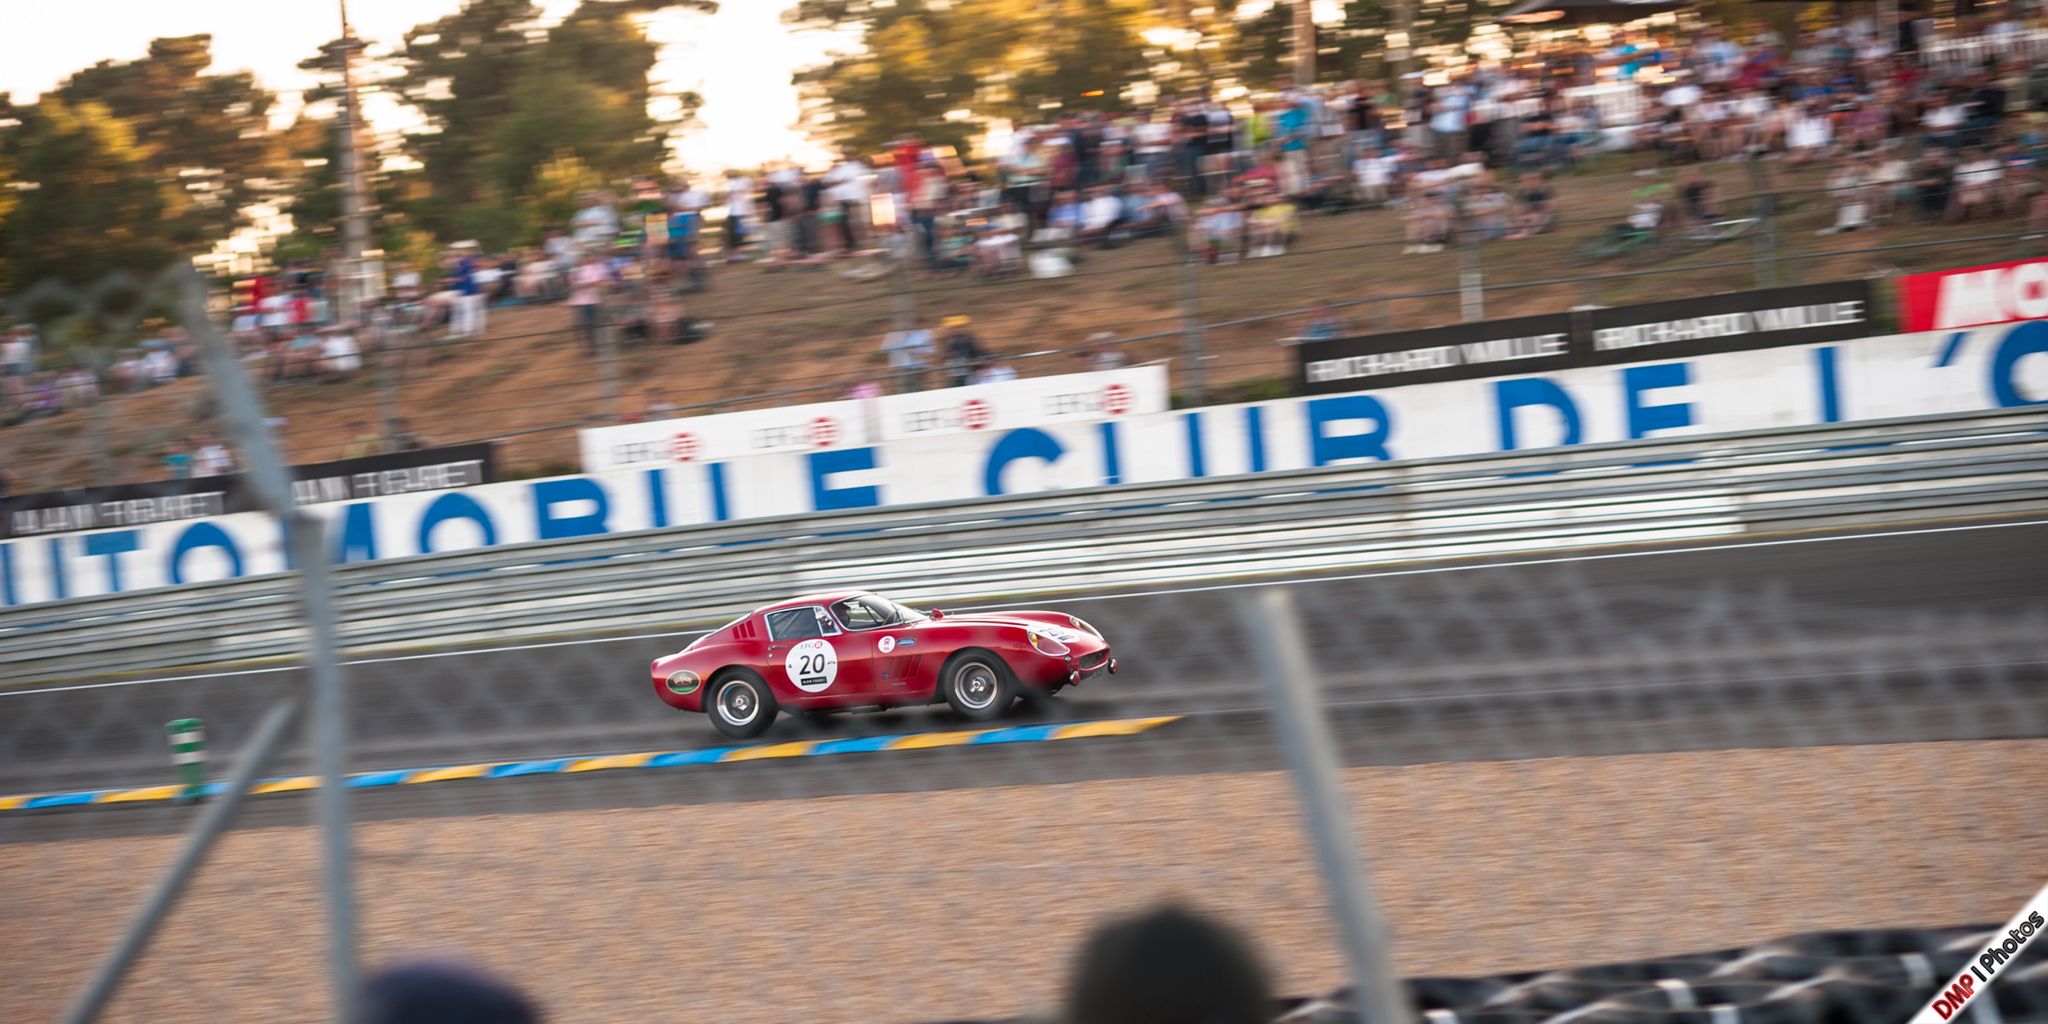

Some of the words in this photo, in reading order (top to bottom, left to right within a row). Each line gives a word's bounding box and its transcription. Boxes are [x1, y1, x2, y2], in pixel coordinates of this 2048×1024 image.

[980, 395, 1394, 496] CLUB
[1494, 362, 1693, 451] DE
[799, 653, 826, 675] 20
